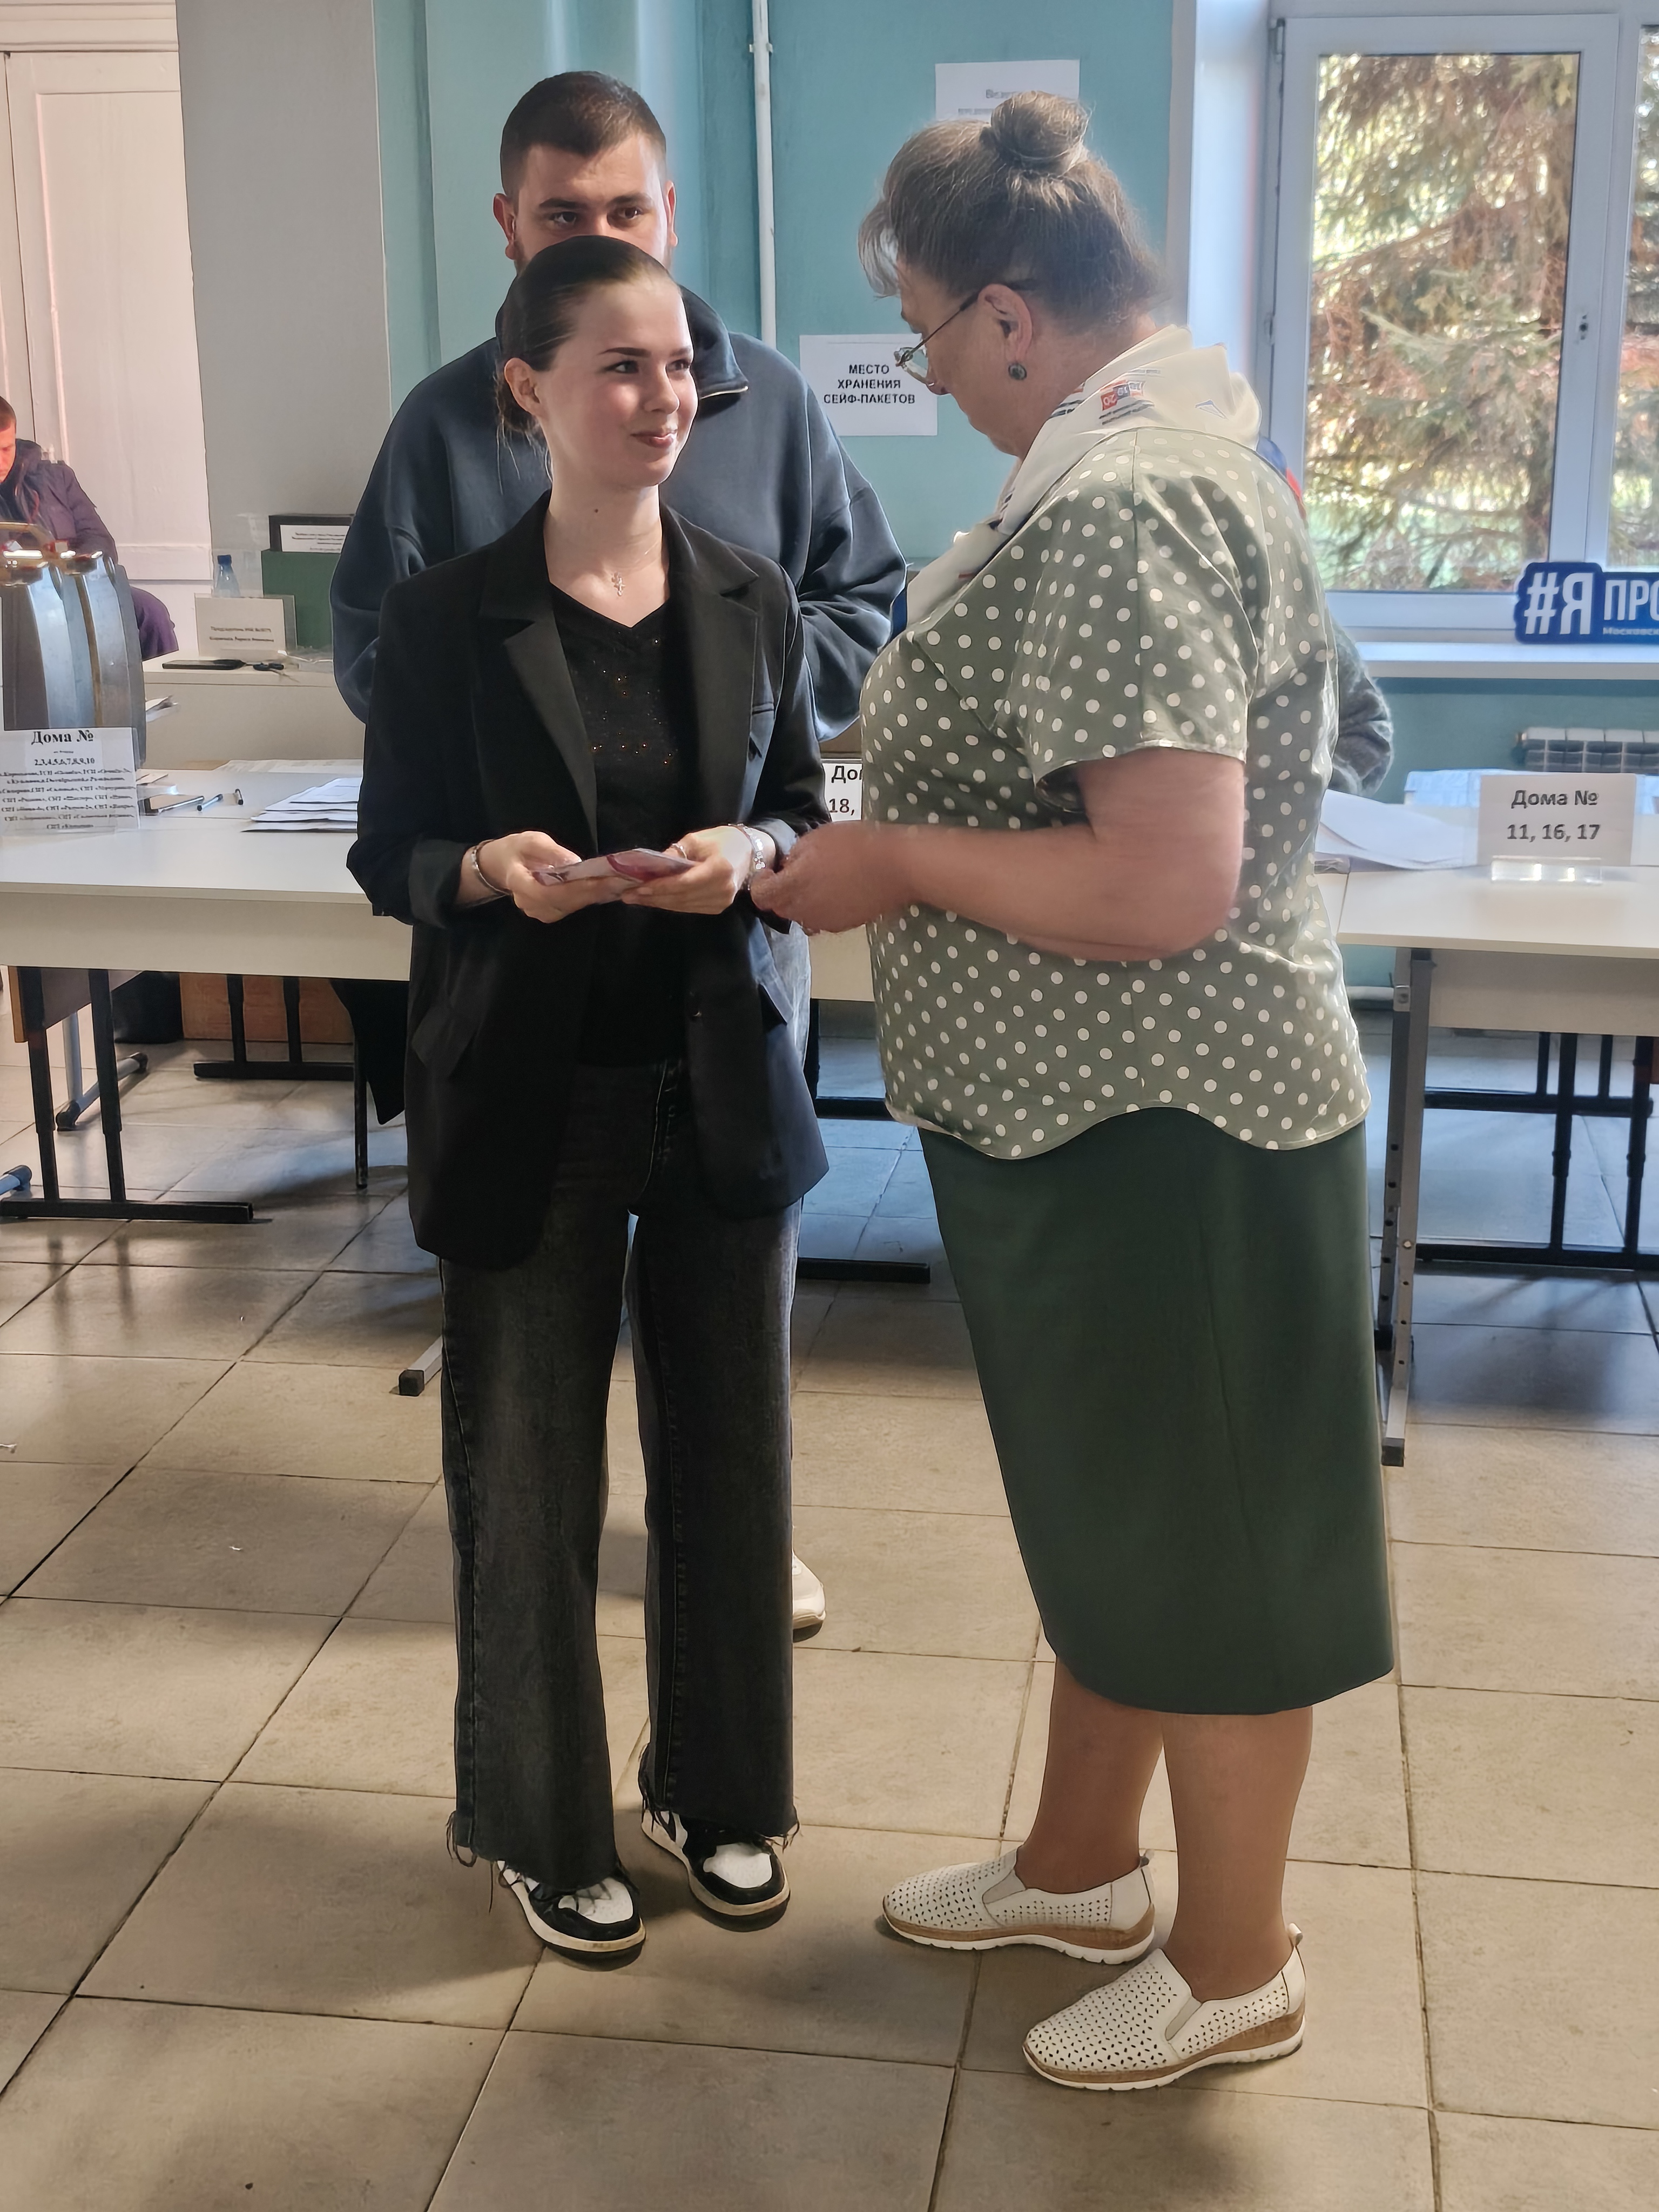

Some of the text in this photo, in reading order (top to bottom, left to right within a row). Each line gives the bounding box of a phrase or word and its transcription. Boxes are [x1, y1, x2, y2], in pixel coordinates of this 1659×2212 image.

[848, 364, 889, 374] МЕСТО
[837, 379, 901, 389] ХРАНЕНИЯ
[824, 394, 915, 404] СЕЙФ-ПАКЕТОВ
[1524, 572, 1593, 635] #Я
[31, 730, 94, 745] Дома №
[831, 766, 863, 784] До
[829, 798, 855, 816] 18,
[1511, 790, 1599, 808] Дома №
[1507, 824, 1601, 842] 11, 16, 17
